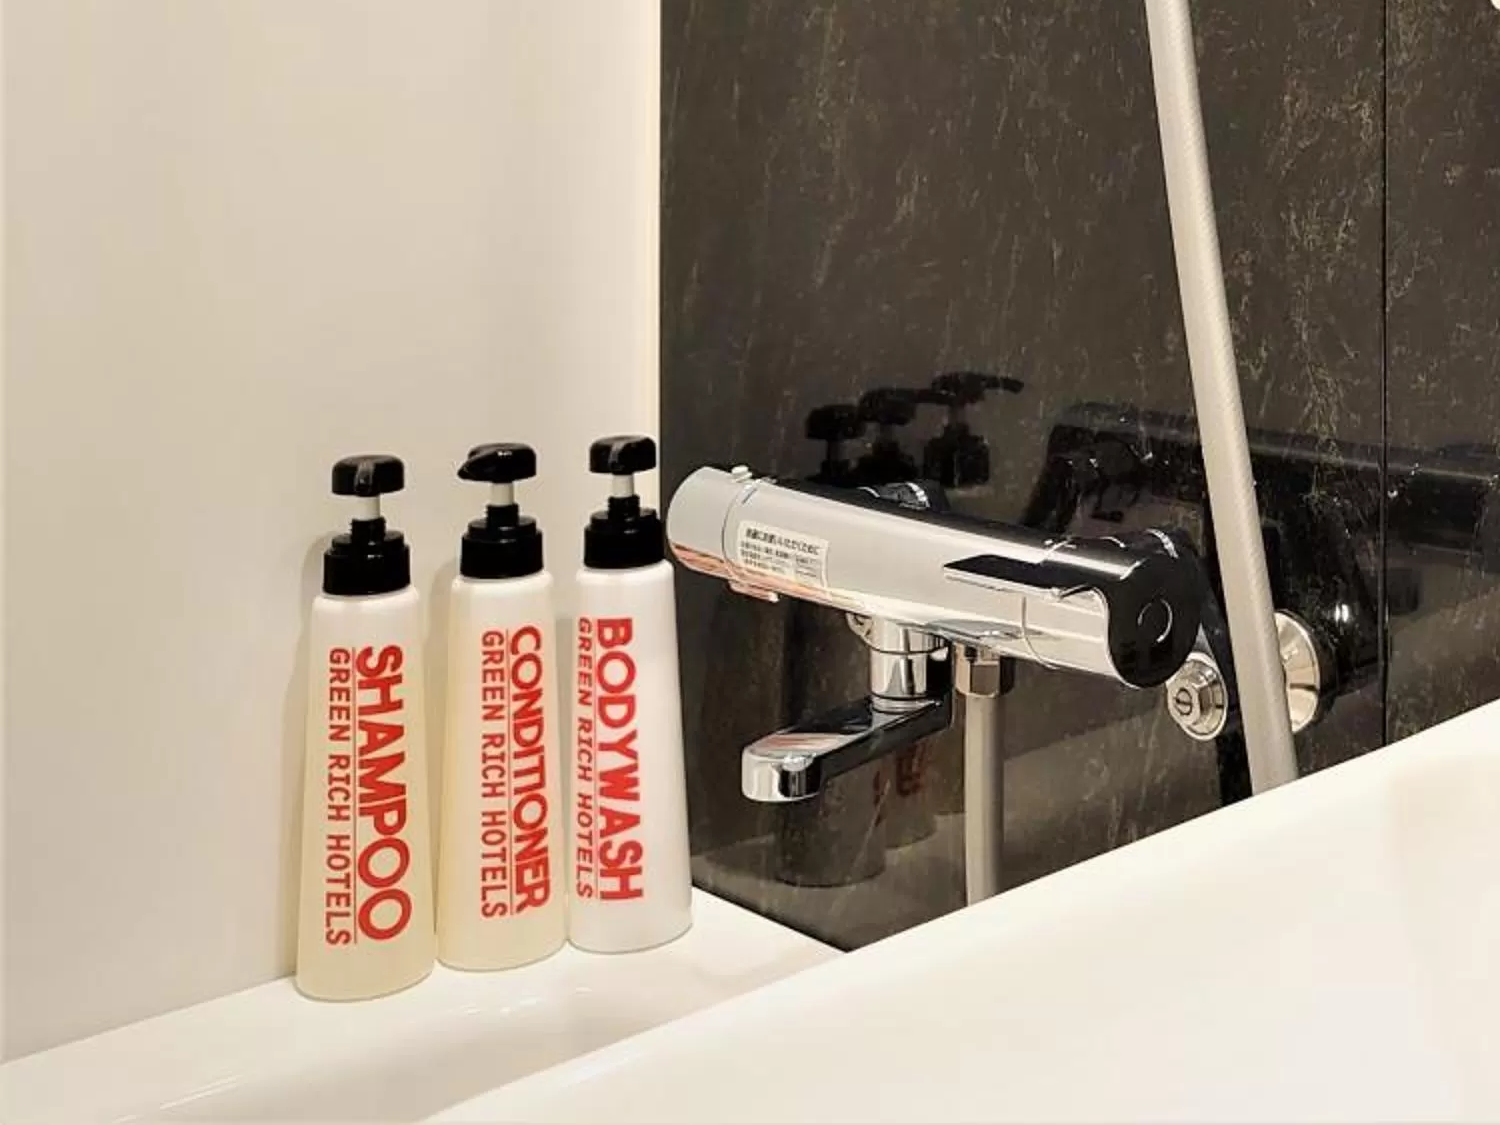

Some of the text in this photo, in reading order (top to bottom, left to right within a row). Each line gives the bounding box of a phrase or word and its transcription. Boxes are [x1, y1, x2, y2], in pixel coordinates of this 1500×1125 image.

[325, 648, 351, 945] GREEN RICH HOTELS
[356, 644, 413, 942] SHAMPOO
[480, 629, 507, 918] GREEN RICH HOTELS
[510, 625, 552, 914] CONDITIONER
[575, 618, 593, 899] GREEN RICH HOTELS
[596, 618, 644, 901] BODYWASH
